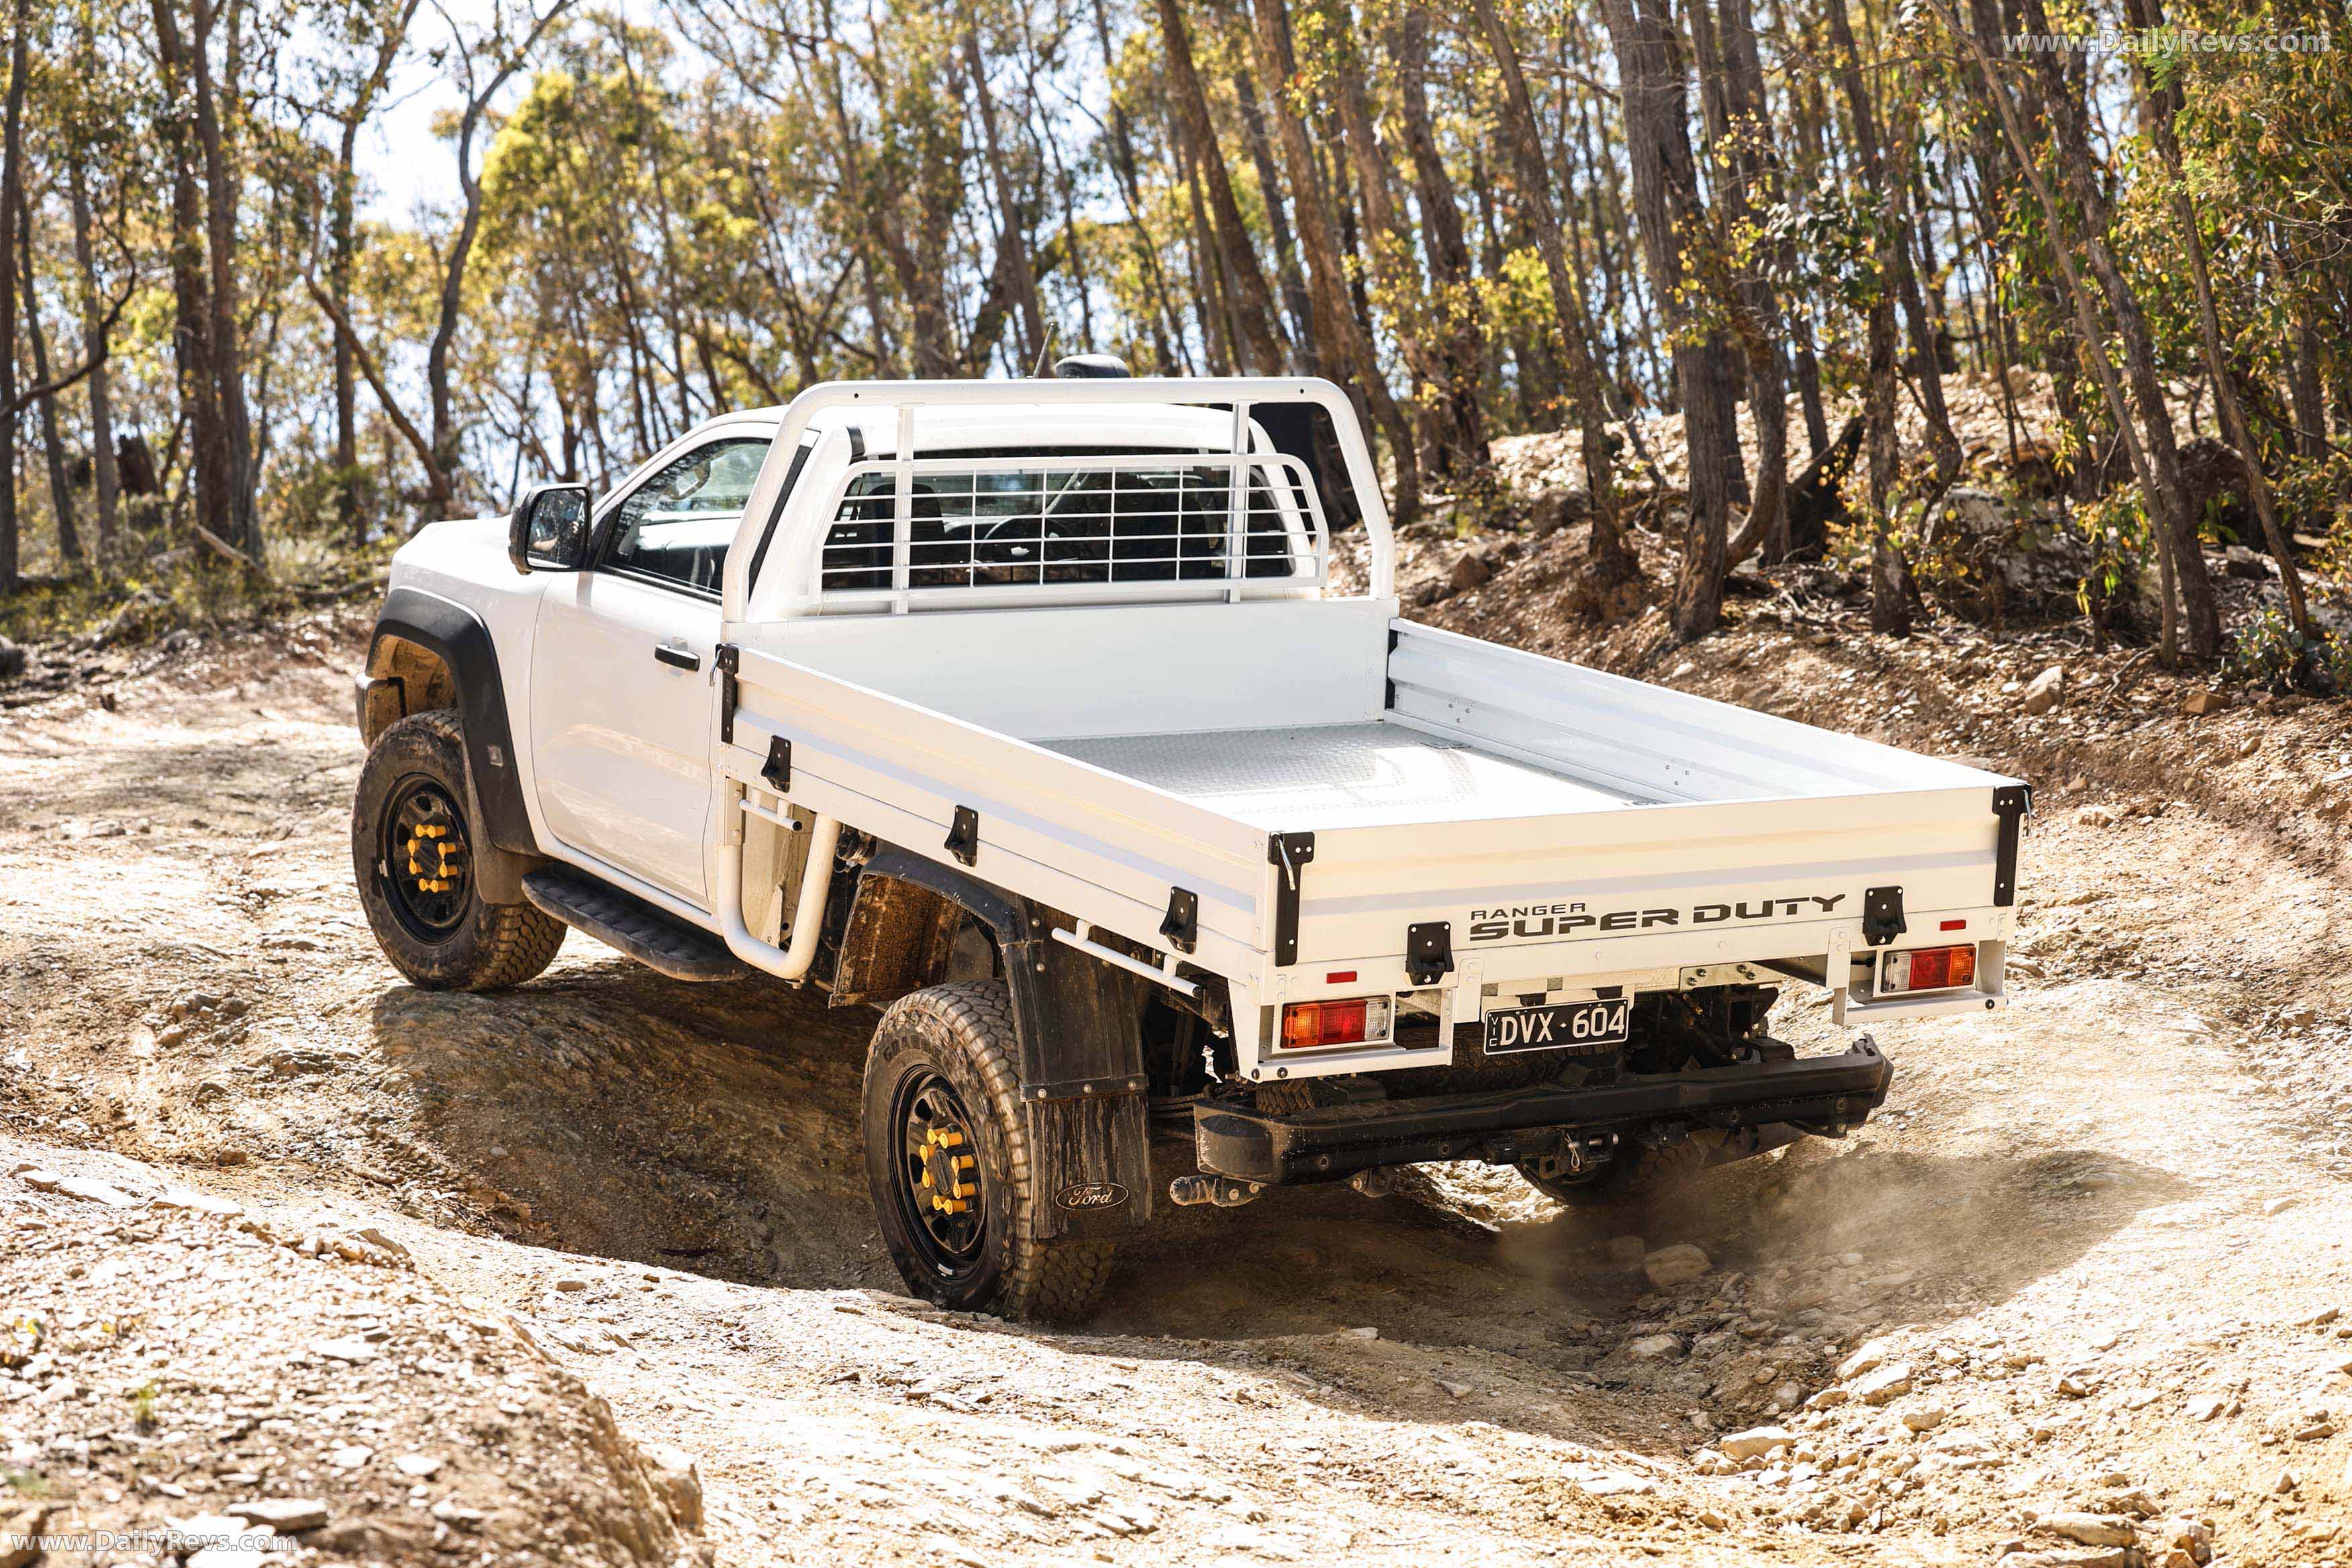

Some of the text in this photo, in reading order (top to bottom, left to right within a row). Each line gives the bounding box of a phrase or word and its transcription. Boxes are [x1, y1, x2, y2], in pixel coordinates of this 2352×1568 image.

[1469, 893, 1846, 942] SUPER DUTY
[1471, 902, 1585, 920] RANGER
[1068, 1186, 1113, 1206] Ford
